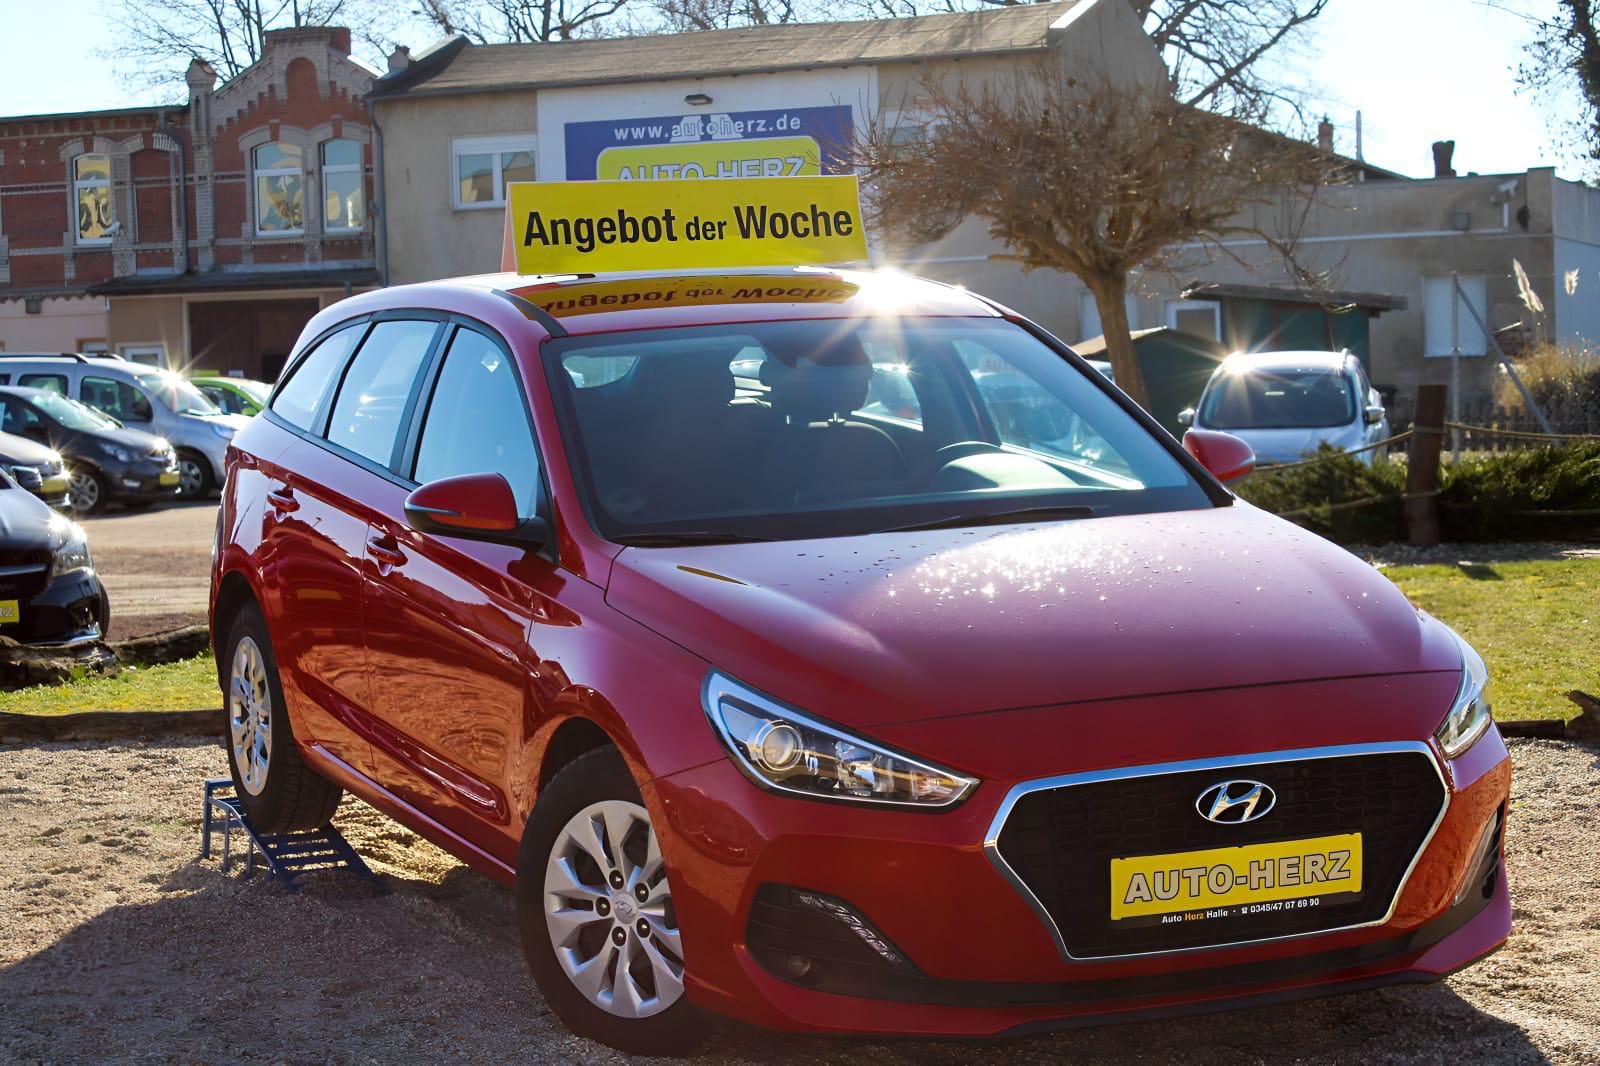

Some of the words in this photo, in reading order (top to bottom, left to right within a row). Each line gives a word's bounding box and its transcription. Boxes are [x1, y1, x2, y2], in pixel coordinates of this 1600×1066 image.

[614, 114, 801, 141] www.autoherz.de
[523, 208, 678, 253] Angebot
[685, 215, 728, 242] der
[733, 204, 854, 240] Woche
[1123, 850, 1352, 904] AUTO-HERZ
[1161, 915, 1183, 924] Auto
[1206, 910, 1228, 919] Halle
